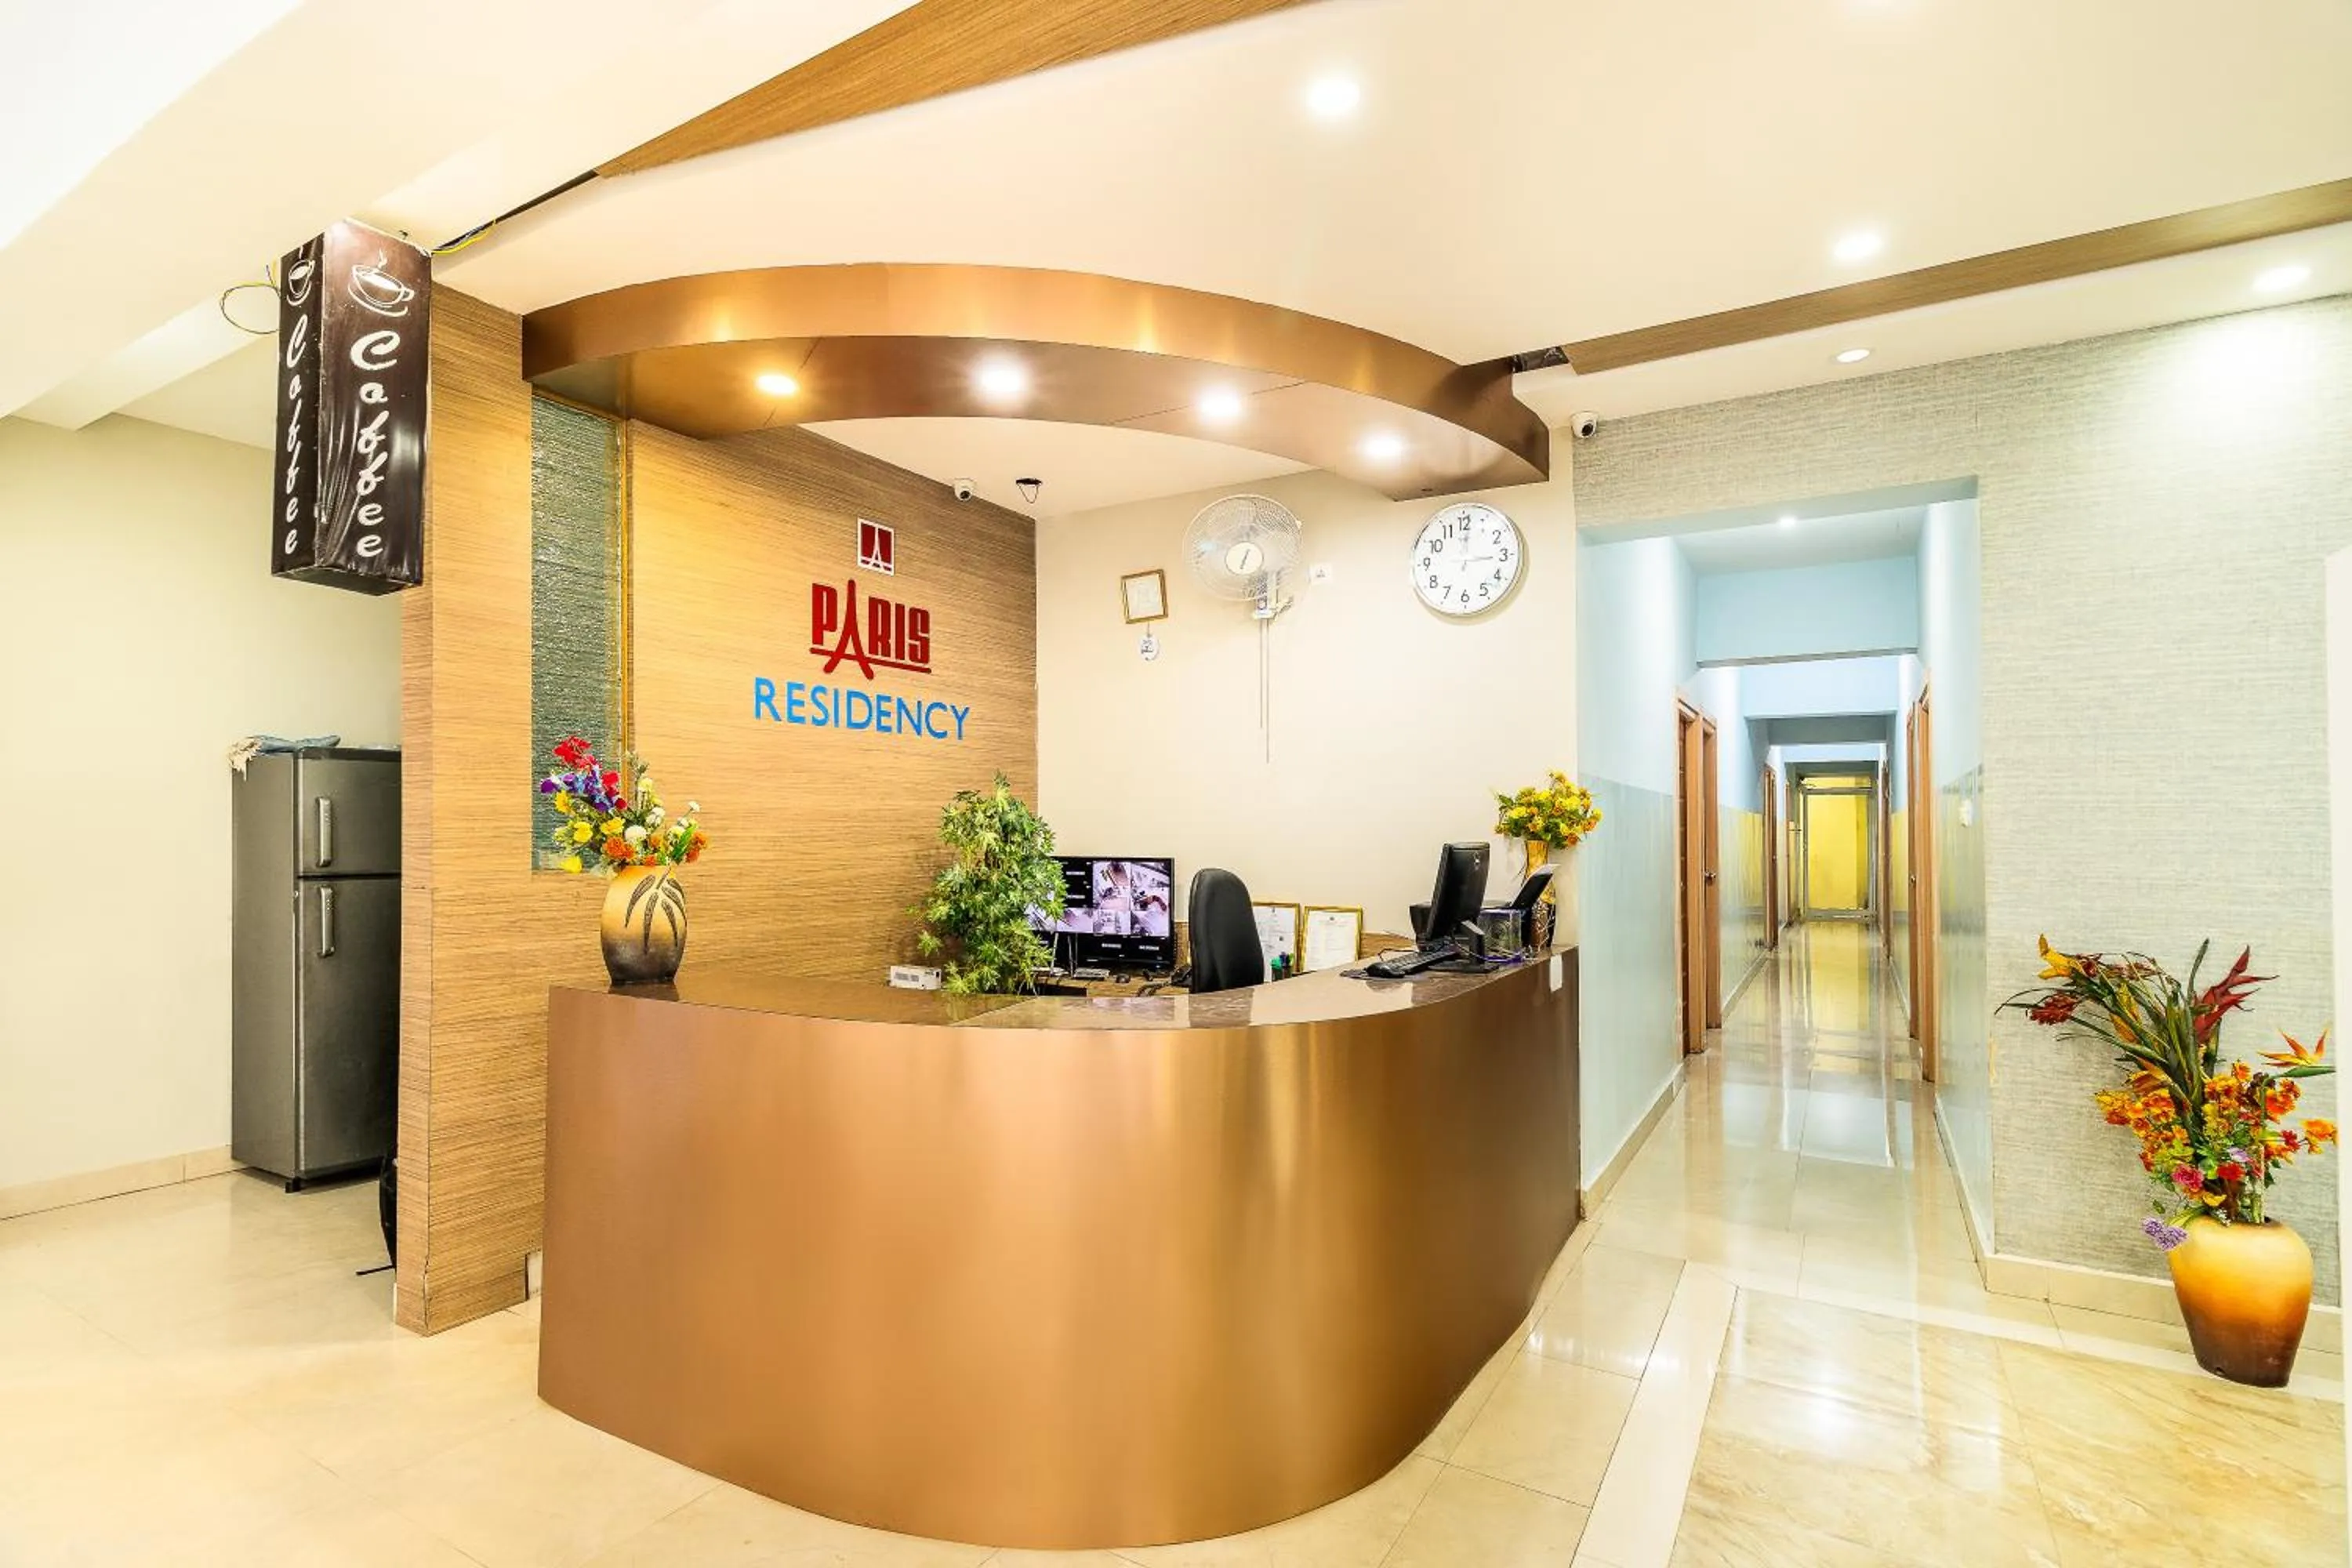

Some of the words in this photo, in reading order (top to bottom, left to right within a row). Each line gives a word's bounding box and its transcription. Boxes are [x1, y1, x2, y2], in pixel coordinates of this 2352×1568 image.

[1457, 514, 1471, 531] 12
[1443, 524, 1453, 539] 11
[1492, 530, 1501, 544] 2
[1429, 539, 1443, 554] 10
[1498, 548, 1508, 562] 3
[1423, 557, 1431, 571] 9
[1429, 575, 1439, 589] 8
[1494, 568, 1501, 582] 4
[1443, 585, 1451, 599] 7
[1461, 590, 1470, 603] 6
[1479, 583, 1489, 597] 5
[810, 579, 931, 680] PARIS
[754, 677, 971, 740] RESIDENCY
